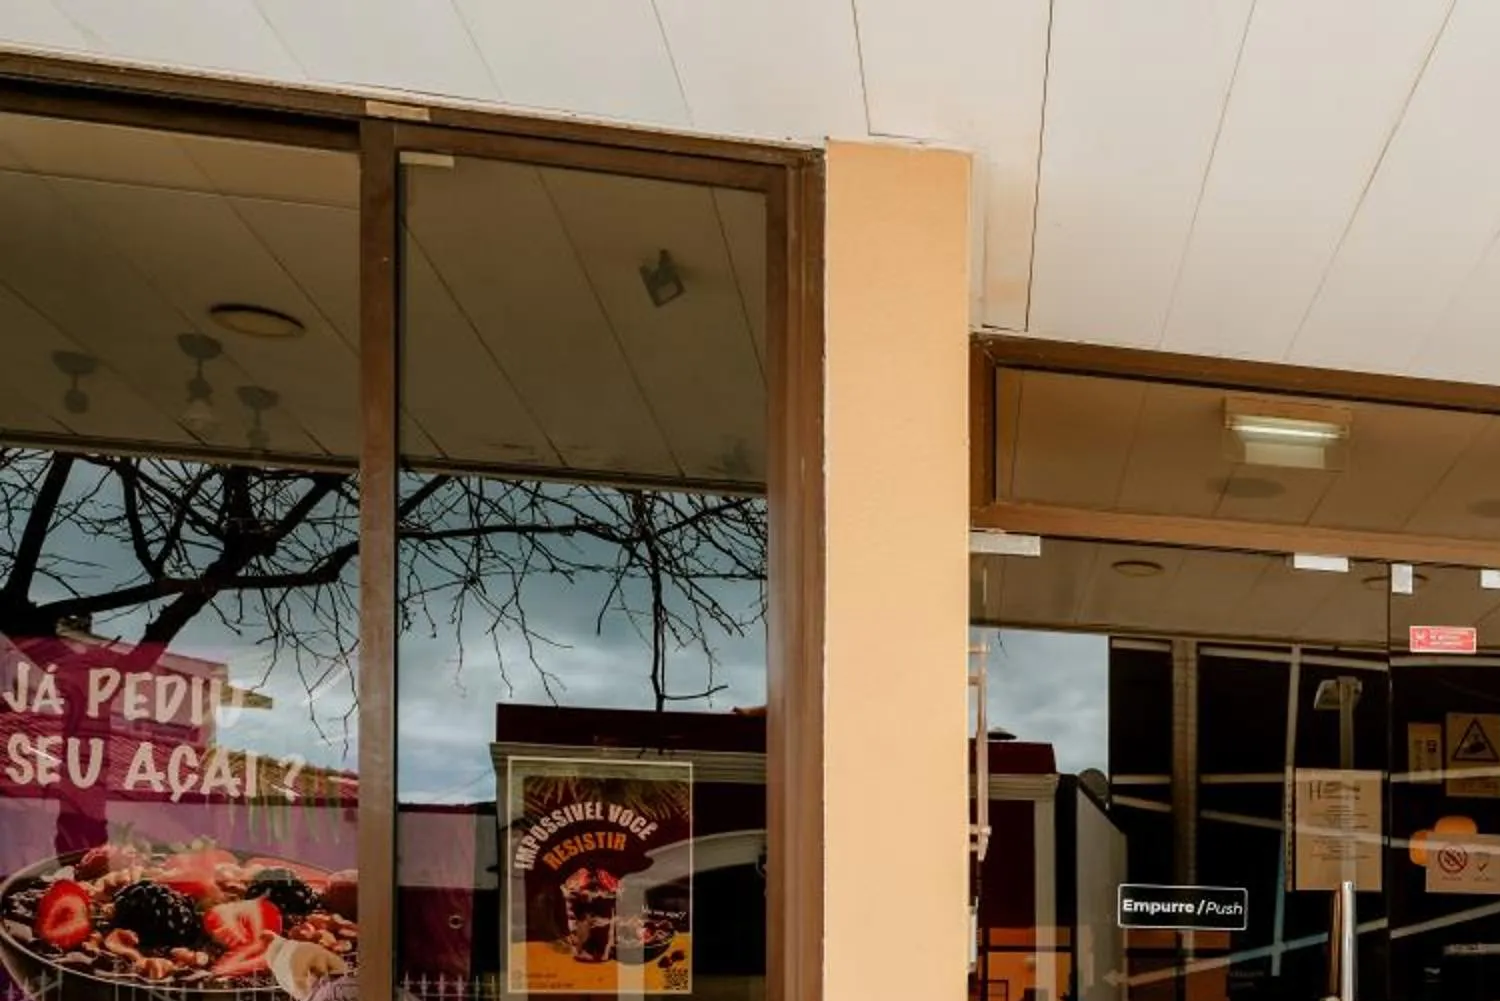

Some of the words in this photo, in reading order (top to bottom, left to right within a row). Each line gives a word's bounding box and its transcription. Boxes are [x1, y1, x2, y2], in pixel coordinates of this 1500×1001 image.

[3, 661, 65, 714] JÁ
[5, 732, 105, 788] SEU
[543, 831, 627, 870] RESISTIR
[1122, 898, 1196, 916] Empurre
